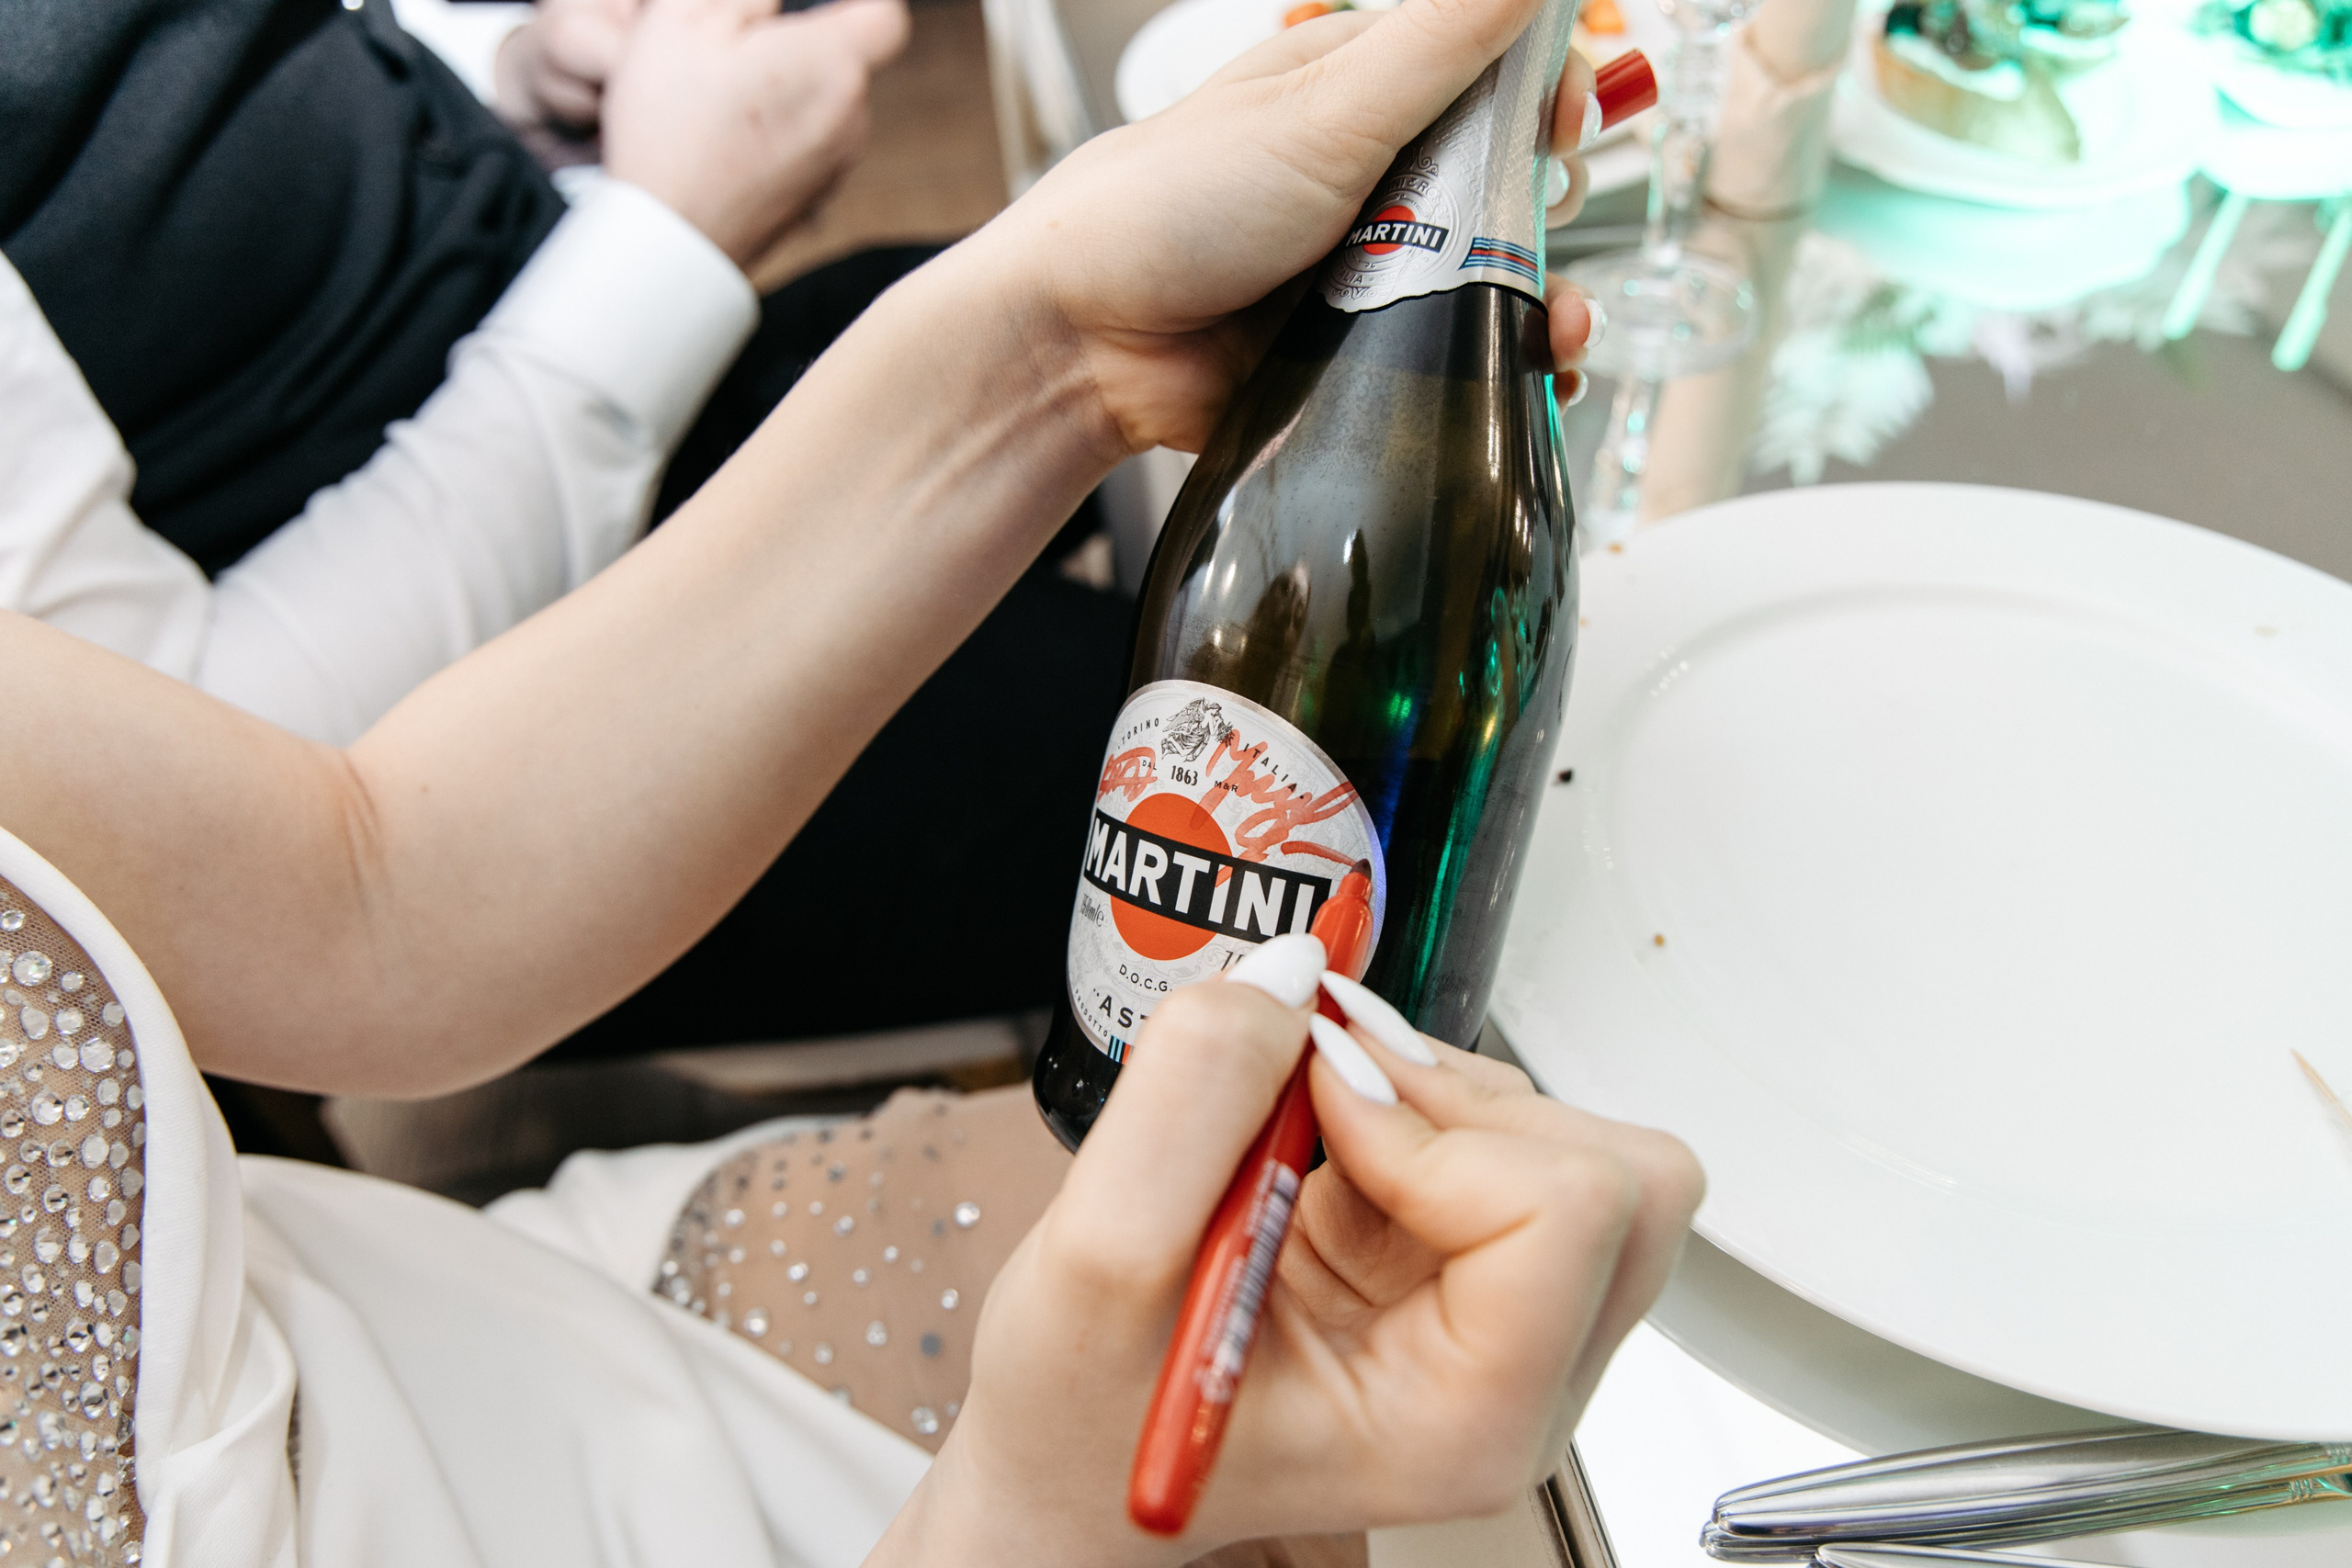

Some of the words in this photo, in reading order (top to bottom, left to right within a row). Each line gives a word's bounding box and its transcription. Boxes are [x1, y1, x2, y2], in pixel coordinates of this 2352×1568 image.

[1345, 223, 1442, 249] MARTINI
[1122, 717, 1159, 744] TORINO
[1243, 743, 1297, 793] ITALIA
[1142, 760, 1158, 771] DAL
[1170, 765, 1198, 786] 1863
[1086, 817, 1315, 938] MARTINI
[1074, 988, 1108, 1038] PRODOTTO
[1099, 994, 1148, 1029] AS
